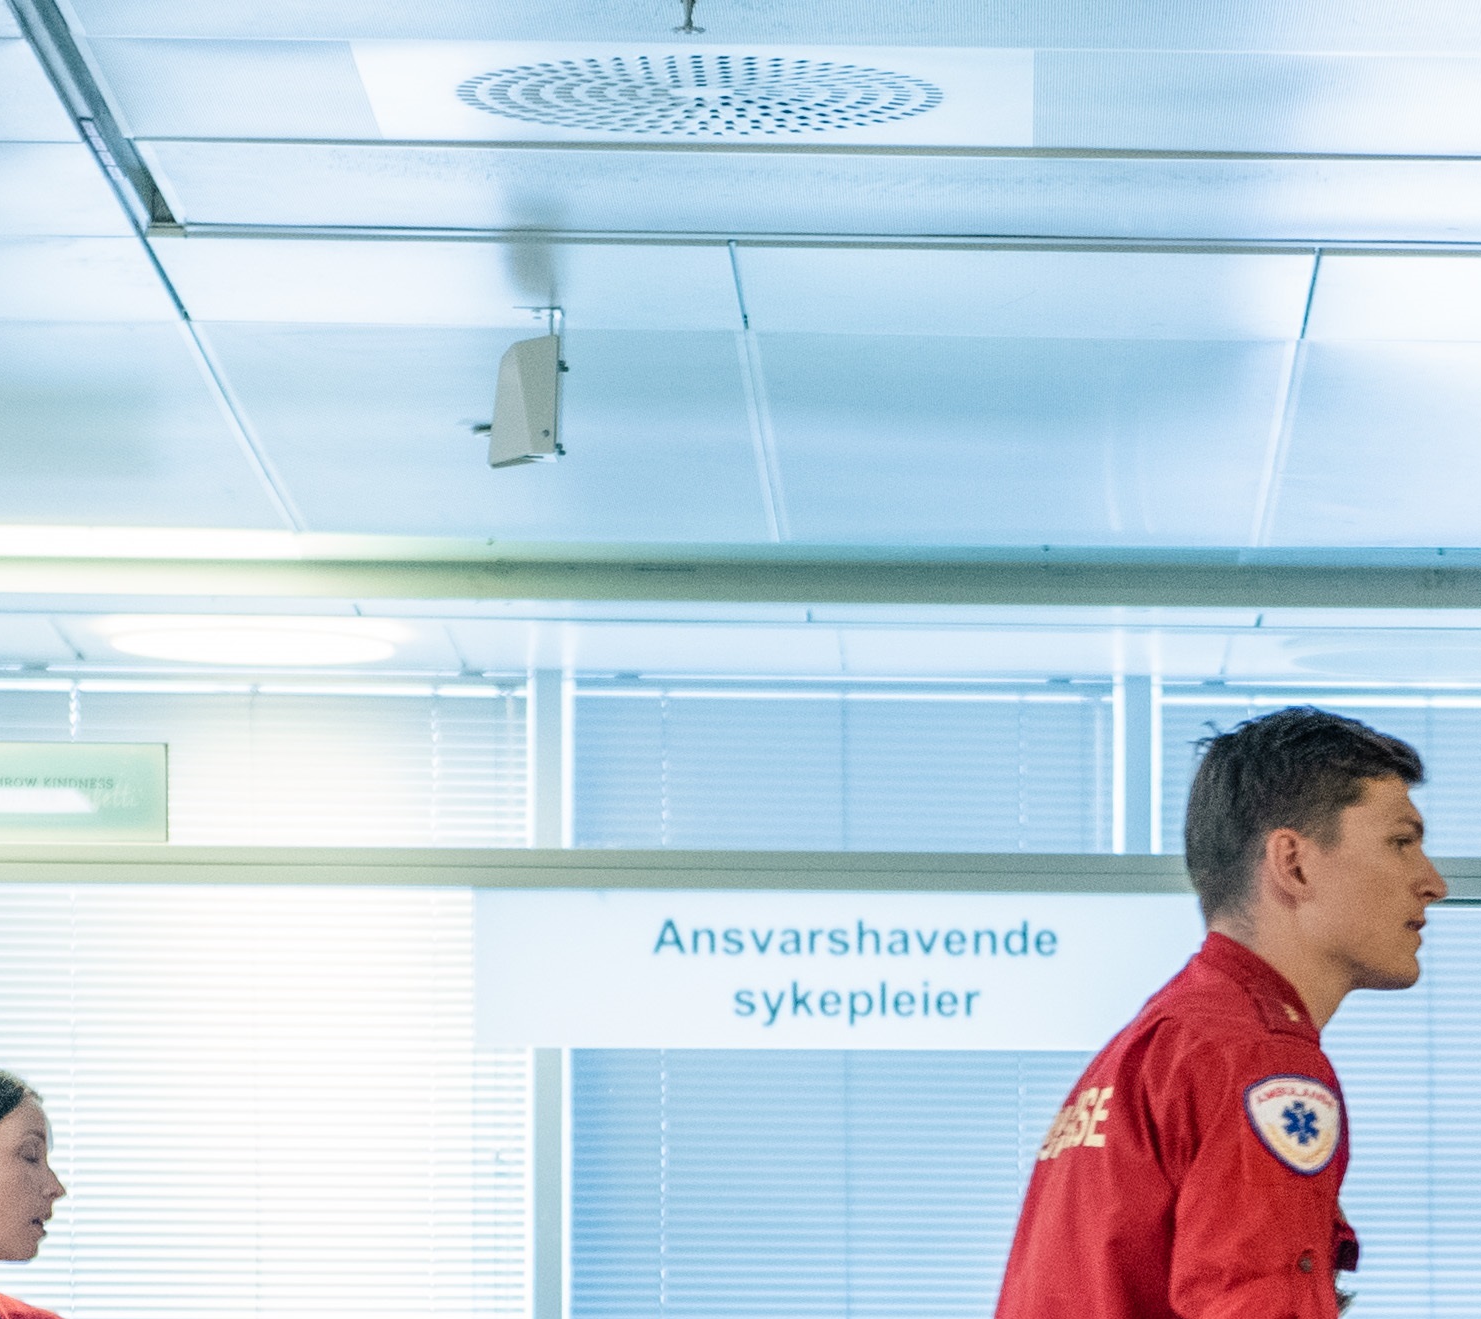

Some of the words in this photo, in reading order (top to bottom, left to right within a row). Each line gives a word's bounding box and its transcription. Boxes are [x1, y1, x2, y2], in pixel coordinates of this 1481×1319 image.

[43, 776, 115, 790] KINDNESS
[652, 918, 1059, 957] Ansvarshavende
[733, 980, 981, 1027] sykepleier
